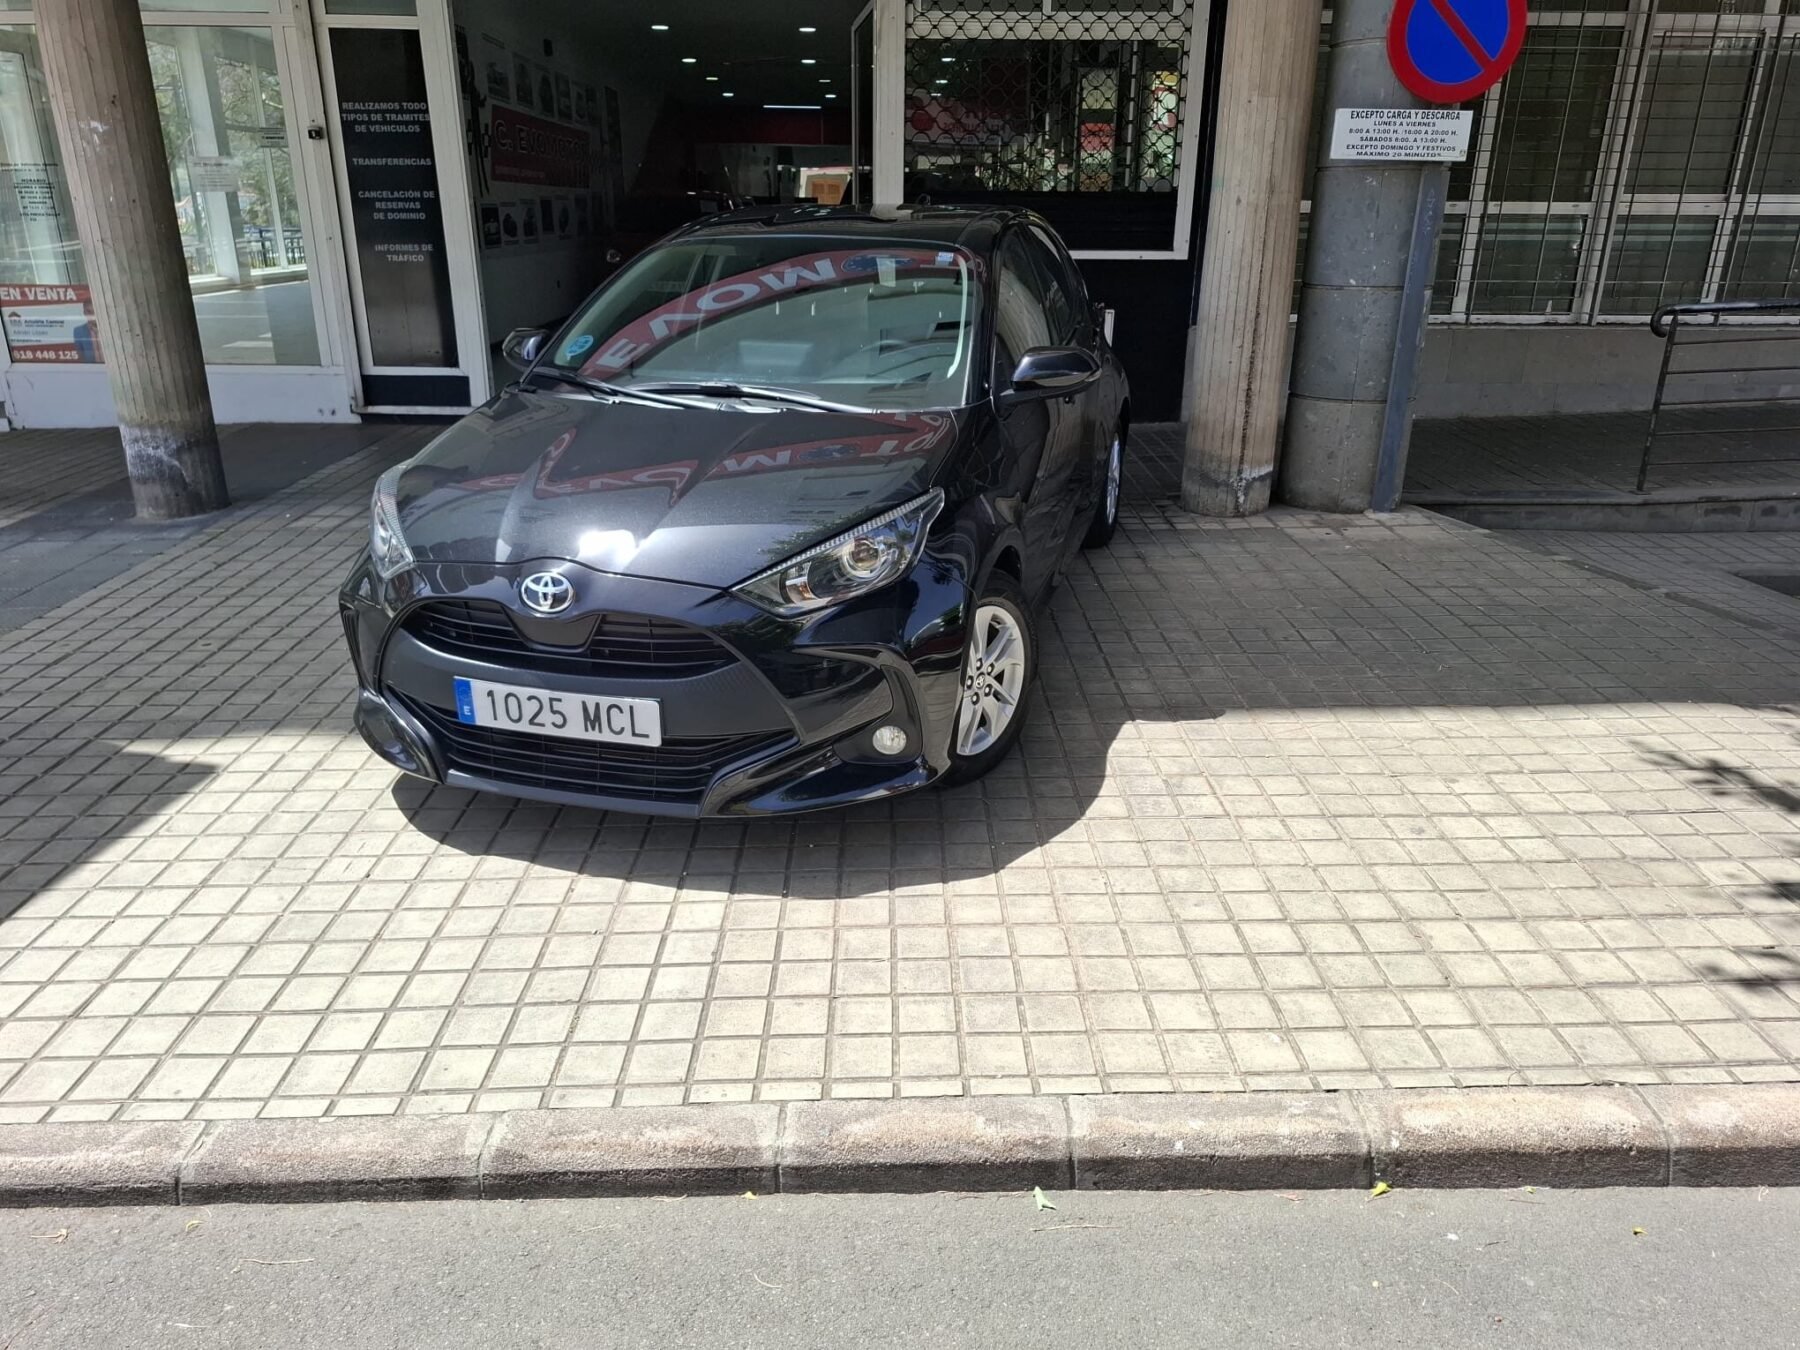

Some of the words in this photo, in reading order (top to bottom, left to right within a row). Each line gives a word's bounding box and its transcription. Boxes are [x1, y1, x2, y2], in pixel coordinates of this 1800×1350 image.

[342, 102, 400, 110] REALIZAMOS
[341, 113, 368, 121] TIPOS
[371, 113, 383, 121] DE
[1350, 110, 1384, 119] EXCEPTO
[1386, 110, 1412, 120] CARGA
[1414, 111, 1420, 120] Y
[1421, 111, 1460, 120] DESCARGA
[423, 190, 435, 198] DE
[375, 201, 421, 209] RESERVAS
[373, 212, 385, 220] DE
[387, 212, 426, 220] DOMINIO
[0, 287, 21, 300] EN
[24, 287, 77, 300] VENTA
[35, 350, 56, 359] 448
[59, 350, 78, 359] 125
[464, 705, 471, 715] E
[486, 689, 568, 729] 1025
[581, 700, 650, 738] MCL
